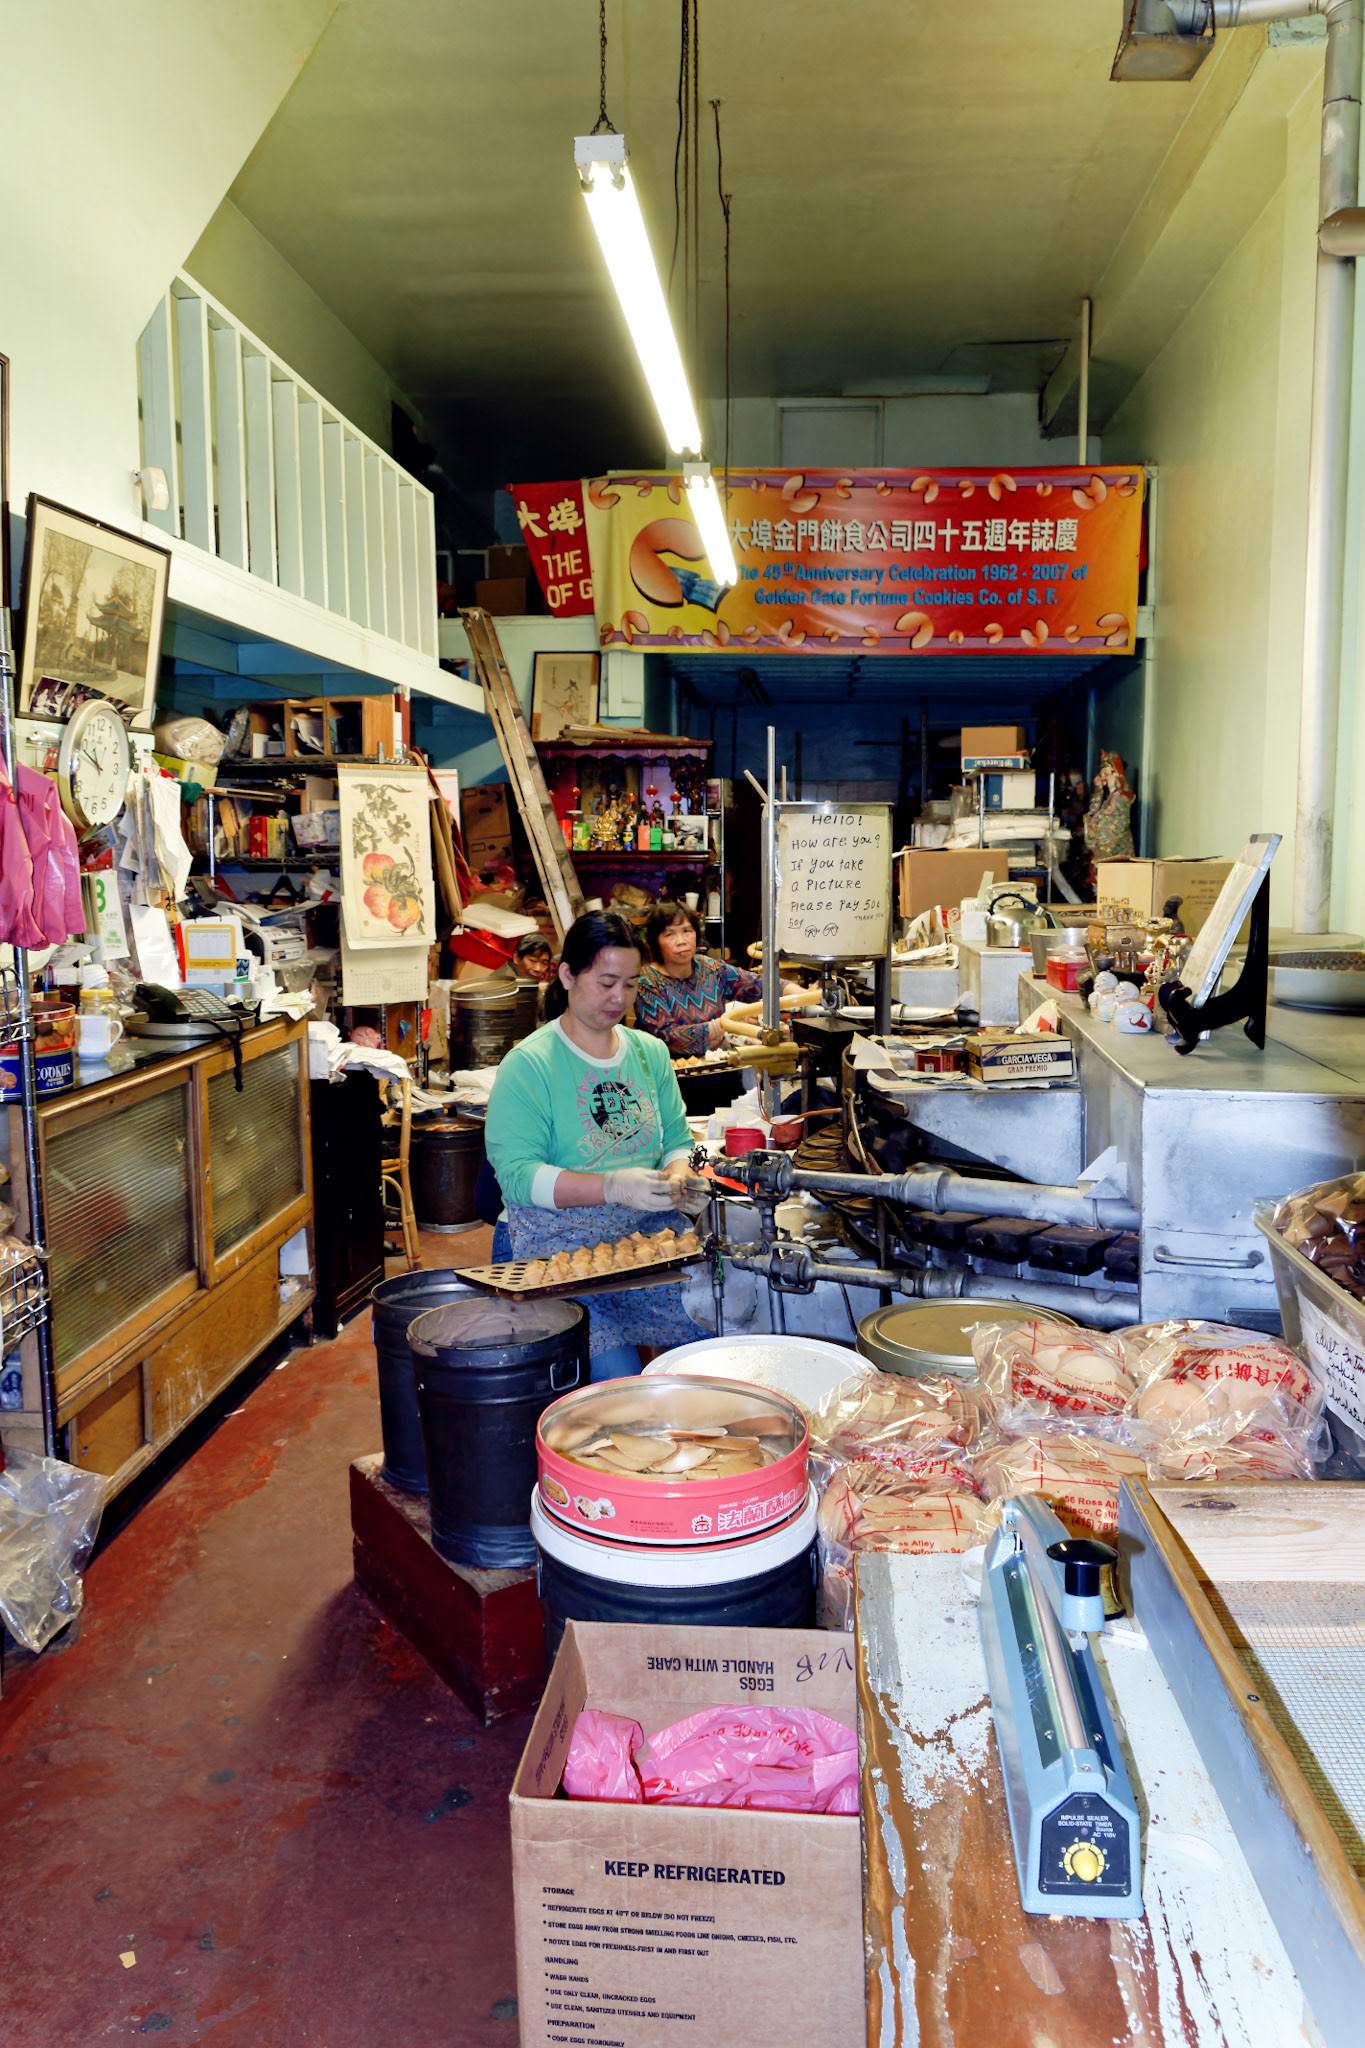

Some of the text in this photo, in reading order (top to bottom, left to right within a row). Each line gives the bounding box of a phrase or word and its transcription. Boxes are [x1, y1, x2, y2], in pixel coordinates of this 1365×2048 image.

[542, 549, 583, 580] THE
[795, 565, 884, 584] Anniversary
[889, 564, 976, 580] Celebration
[981, 564, 1017, 580] 1962
[1031, 565, 1067, 580] 2007
[1072, 564, 1087, 580] of
[547, 579, 593, 608] OF G
[755, 587, 1057, 605] Golden Gate Fortune Cookies Co. of S. F.
[792, 839, 818, 850] How
[822, 836, 848, 848] are
[809, 858, 834, 873] you
[839, 858, 864, 871] take
[1002, 1054, 1029, 1065] GARCIA
[1032, 1053, 1053, 1063] VEGA
[1008, 1064, 1048, 1074] GRAN PREMIO
[1064, 1496, 1118, 1509] 56 Ross All
[1055, 1505, 1119, 1520] ncisco, Calif
[911, 1540, 935, 1549] Alley
[647, 1656, 774, 1675] HANDLE WITH CARE
[739, 1676, 775, 1692] EGGS
[604, 1860, 786, 1886] KEEP REFRIGERATED
[542, 1887, 575, 1896] STORAGE
[547, 1904, 587, 1914] REFRIGERATE
[641, 1911, 662, 1920] BELOW
[548, 1921, 567, 1929] STORE
[585, 1924, 601, 1932] AWAY
[602, 1926, 619, 1934] FROM
[620, 1927, 644, 1936] STRONG
[645, 1929, 675, 1938] SMELLING
[676, 1931, 696, 1939] FOODS
[549, 1938, 571, 1946] ROTATE
[572, 1940, 588, 1948] EGGS
[589, 1941, 601, 1949] FOR
[664, 1947, 677, 1955] AND
[678, 1948, 695, 1956] FIRST
[545, 1956, 579, 1966] HANDLING
[550, 1973, 589, 1983] WASH HANDS
[563, 1989, 579, 1997] ONLY
[580, 1991, 601, 2000] CLEAN,
[602, 1993, 639, 2003] UNCRACKED
[564, 2004, 585, 2013] CLEAN,
[585, 2006, 616, 2015] SANITIZED
[617, 2009, 646, 2017] UTENSILS
[661, 2012, 696, 2021] EQUIPMENT
[547, 2019, 596, 2030] PREPARATION
[552, 2035, 625, 2048] COOK EGGS THOROUGHLY
